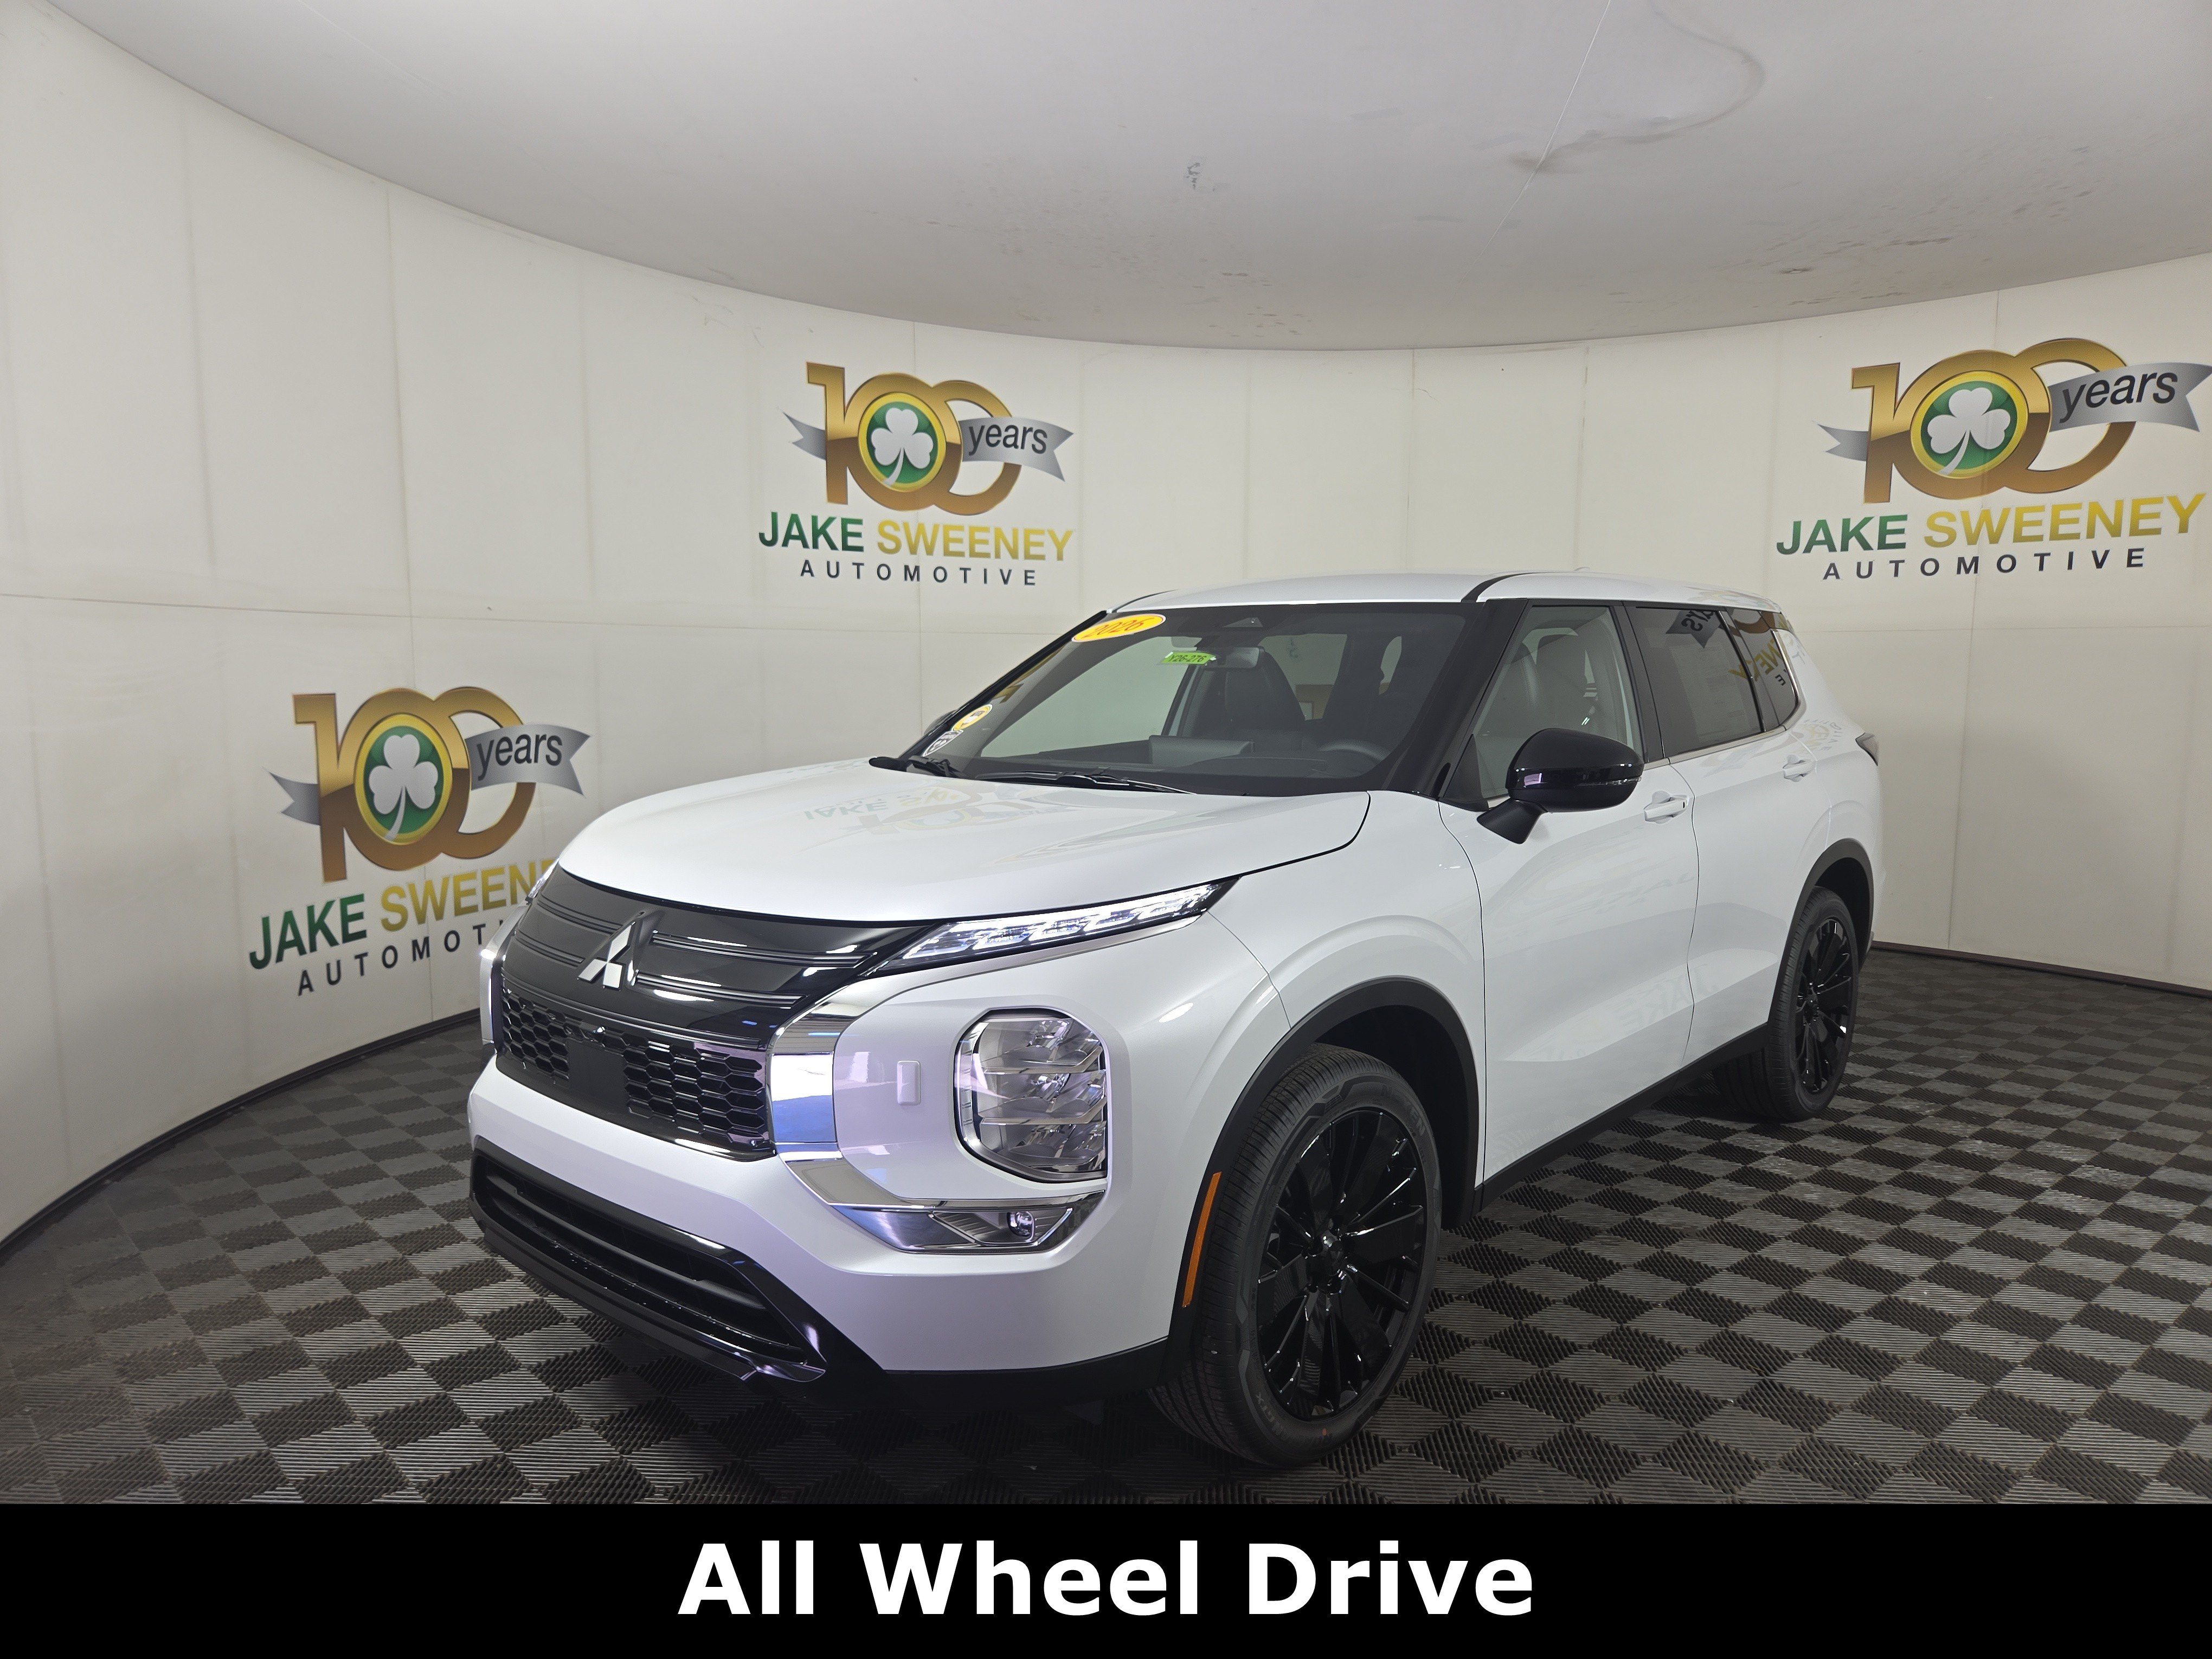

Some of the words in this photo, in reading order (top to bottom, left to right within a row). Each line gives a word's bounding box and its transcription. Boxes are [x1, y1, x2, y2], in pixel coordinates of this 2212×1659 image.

[806, 362, 1022, 516] 100
[968, 423, 1047, 456] years
[1850, 338, 2137, 504] 100
[2060, 371, 2178, 423] years
[759, 511, 864, 552] JAKE
[877, 520, 1073, 561] SWEENEY
[1776, 514, 1907, 556] JAKE
[1924, 493, 2205, 548] SWEENEY
[801, 560, 1035, 586] AUTOMOTIVE
[1823, 548, 2144, 580] AUTOMOTIVE
[1081, 618, 1155, 639] 2026
[293, 686, 536, 883] 100
[477, 734, 562, 781] years
[249, 894, 367, 970] JAKE
[381, 859, 554, 931] SWEEN
[297, 919, 503, 996] AUTOMOT
